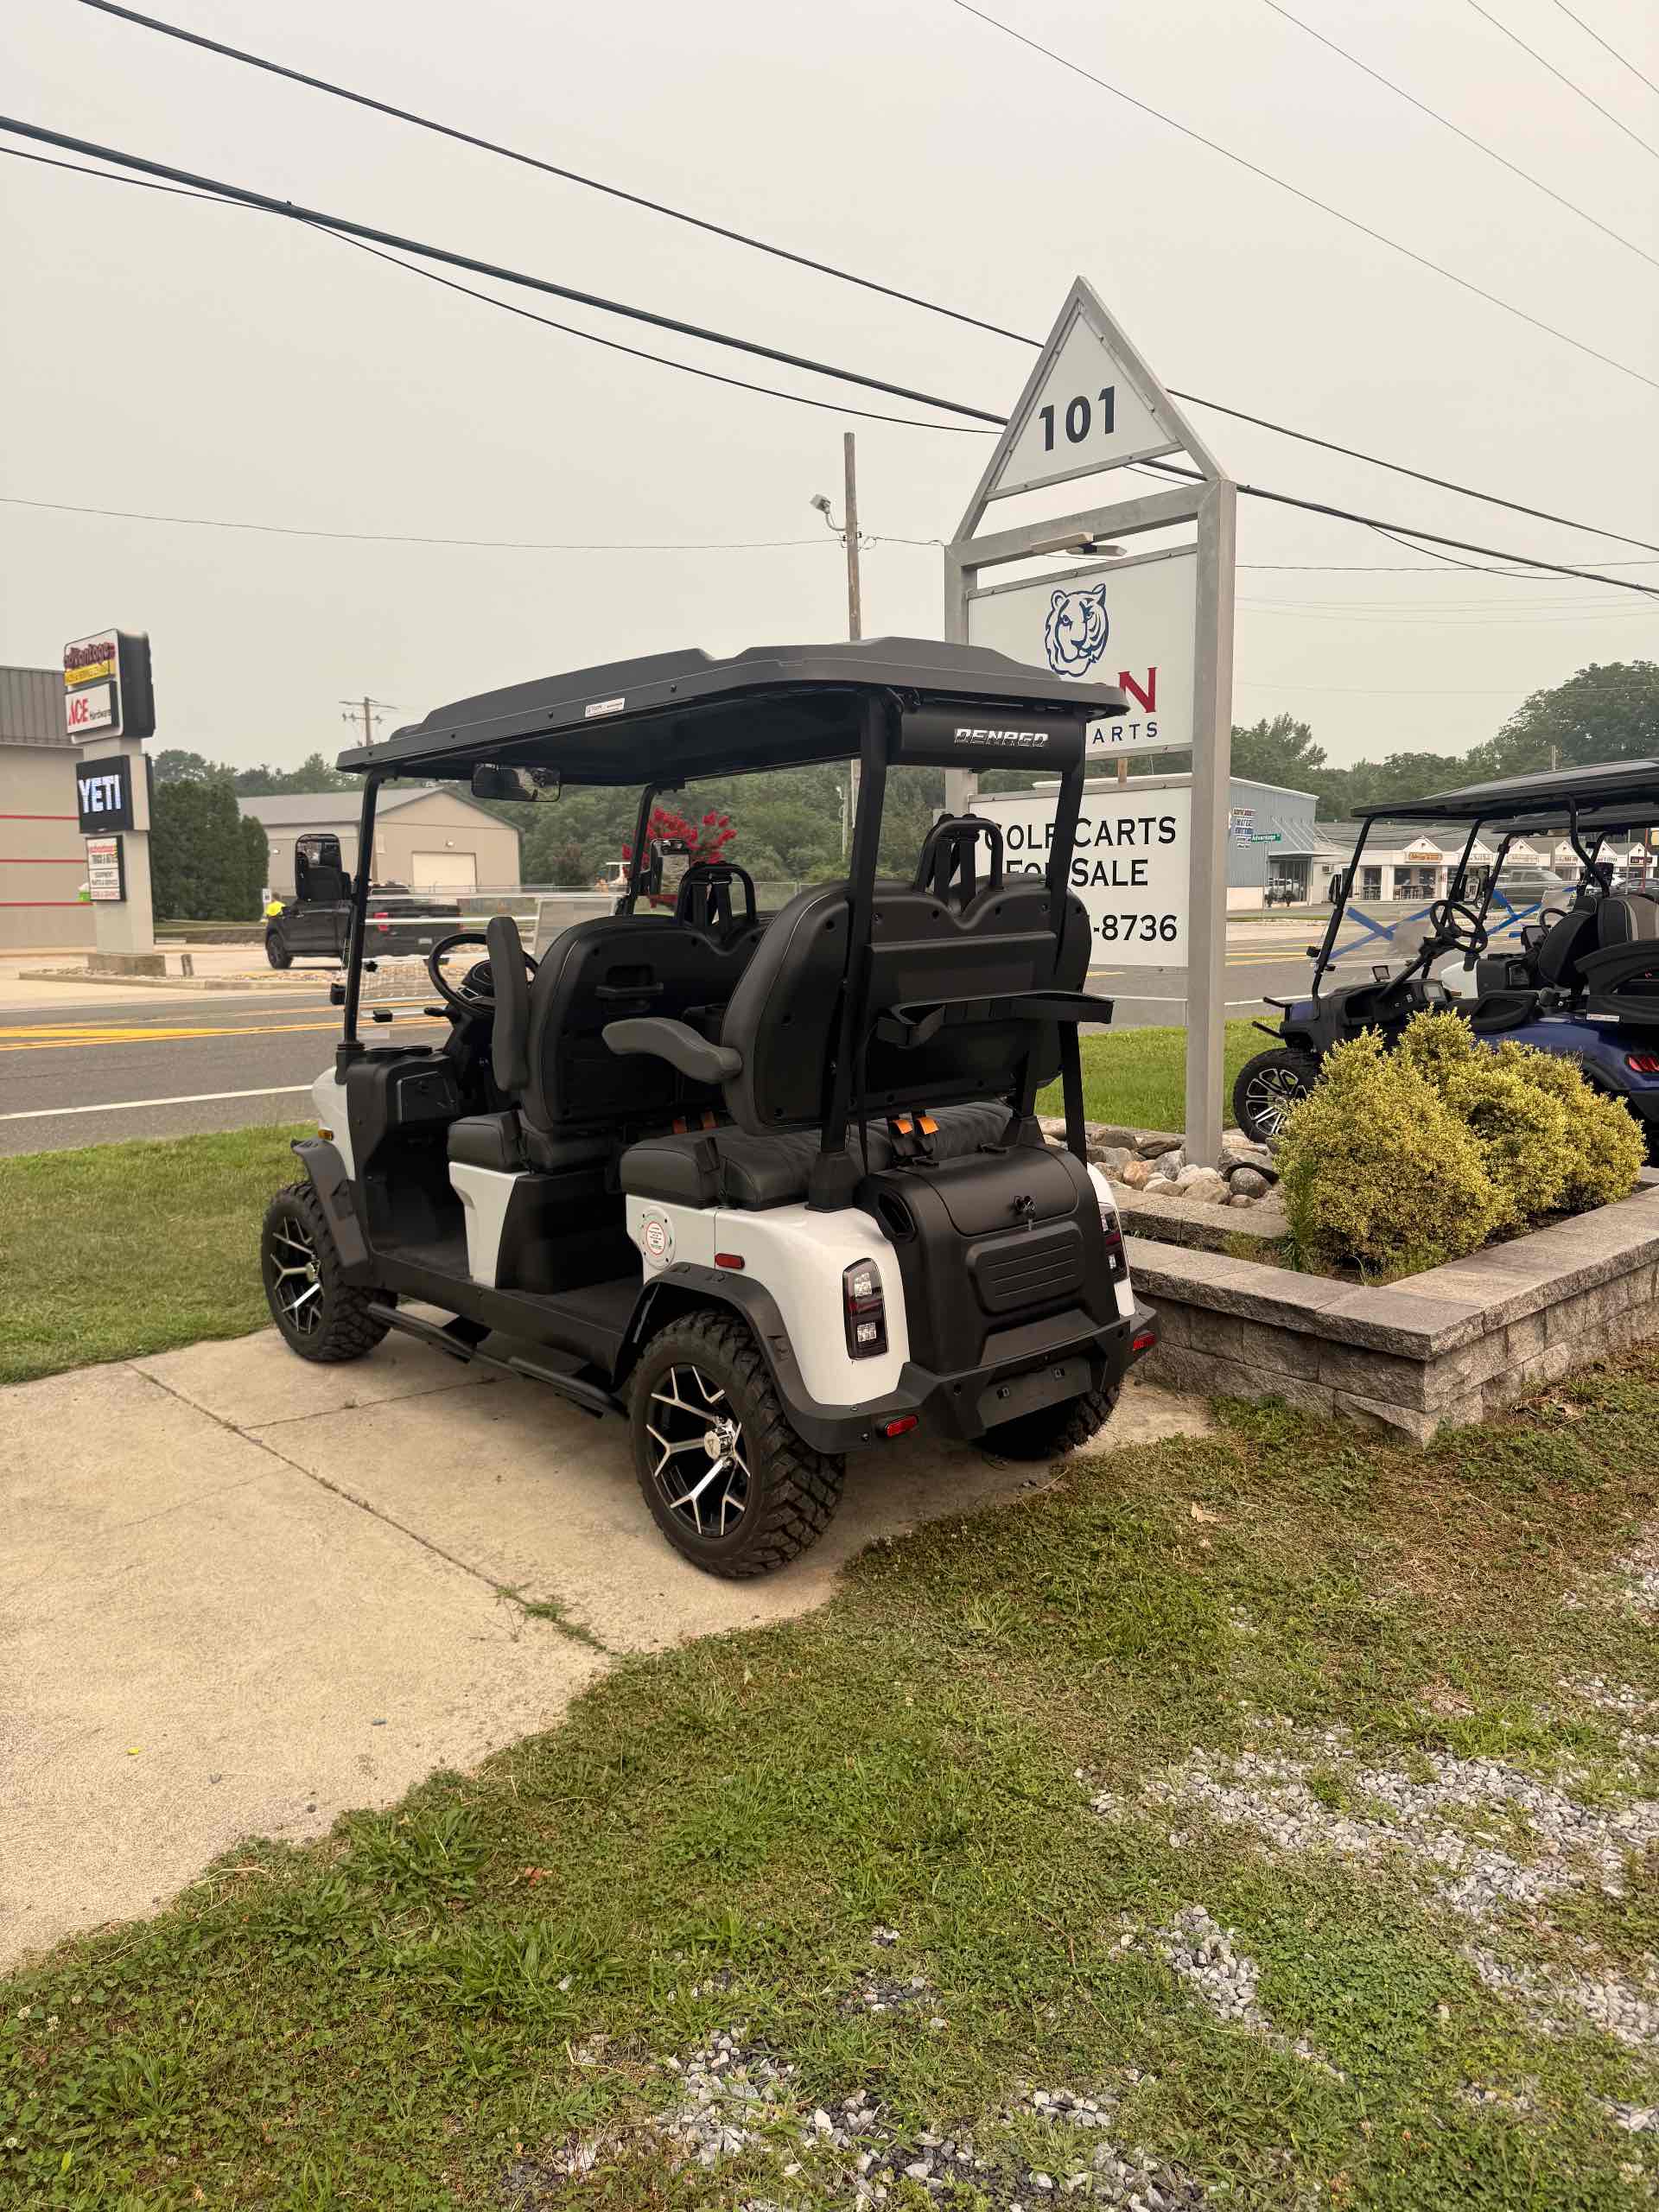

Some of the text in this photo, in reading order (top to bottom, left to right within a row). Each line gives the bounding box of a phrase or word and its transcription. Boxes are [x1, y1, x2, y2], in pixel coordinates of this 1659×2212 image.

[1039, 385, 1115, 451] 101
[78, 773, 122, 814] YETI
[1074, 816, 1176, 848] CARTS
[1071, 858, 1148, 887] SALE
